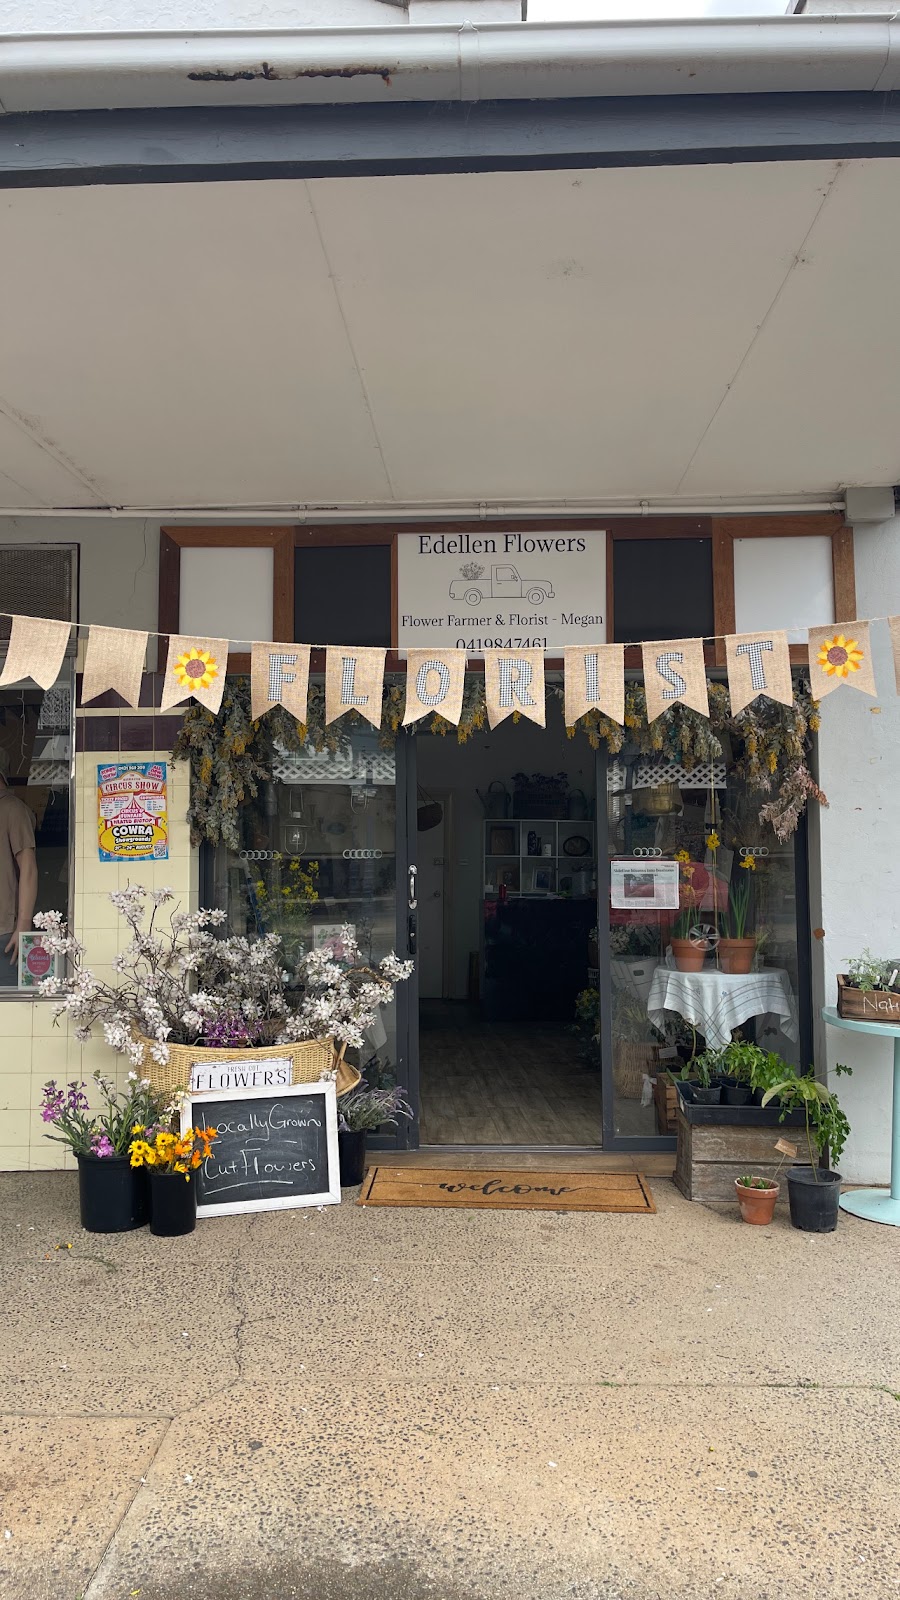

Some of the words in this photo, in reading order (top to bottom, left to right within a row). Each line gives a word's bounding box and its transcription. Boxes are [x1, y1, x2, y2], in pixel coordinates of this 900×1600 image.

[418, 535, 497, 554] Edellen
[503, 533, 586, 553] Flowers
[401, 615, 443, 627] Flower
[447, 614, 492, 626] Farmer
[495, 614, 505, 626] &
[508, 613, 549, 625] Florist
[561, 613, 603, 627] Megan
[456, 638, 548, 652] 0419847461
[106, 781, 132, 792] CIRCUS
[136, 781, 159, 790] SHOW
[113, 825, 153, 836] COWRA
[196, 1070, 287, 1090] FLOWERS
[438, 1179, 575, 1196] welcome
